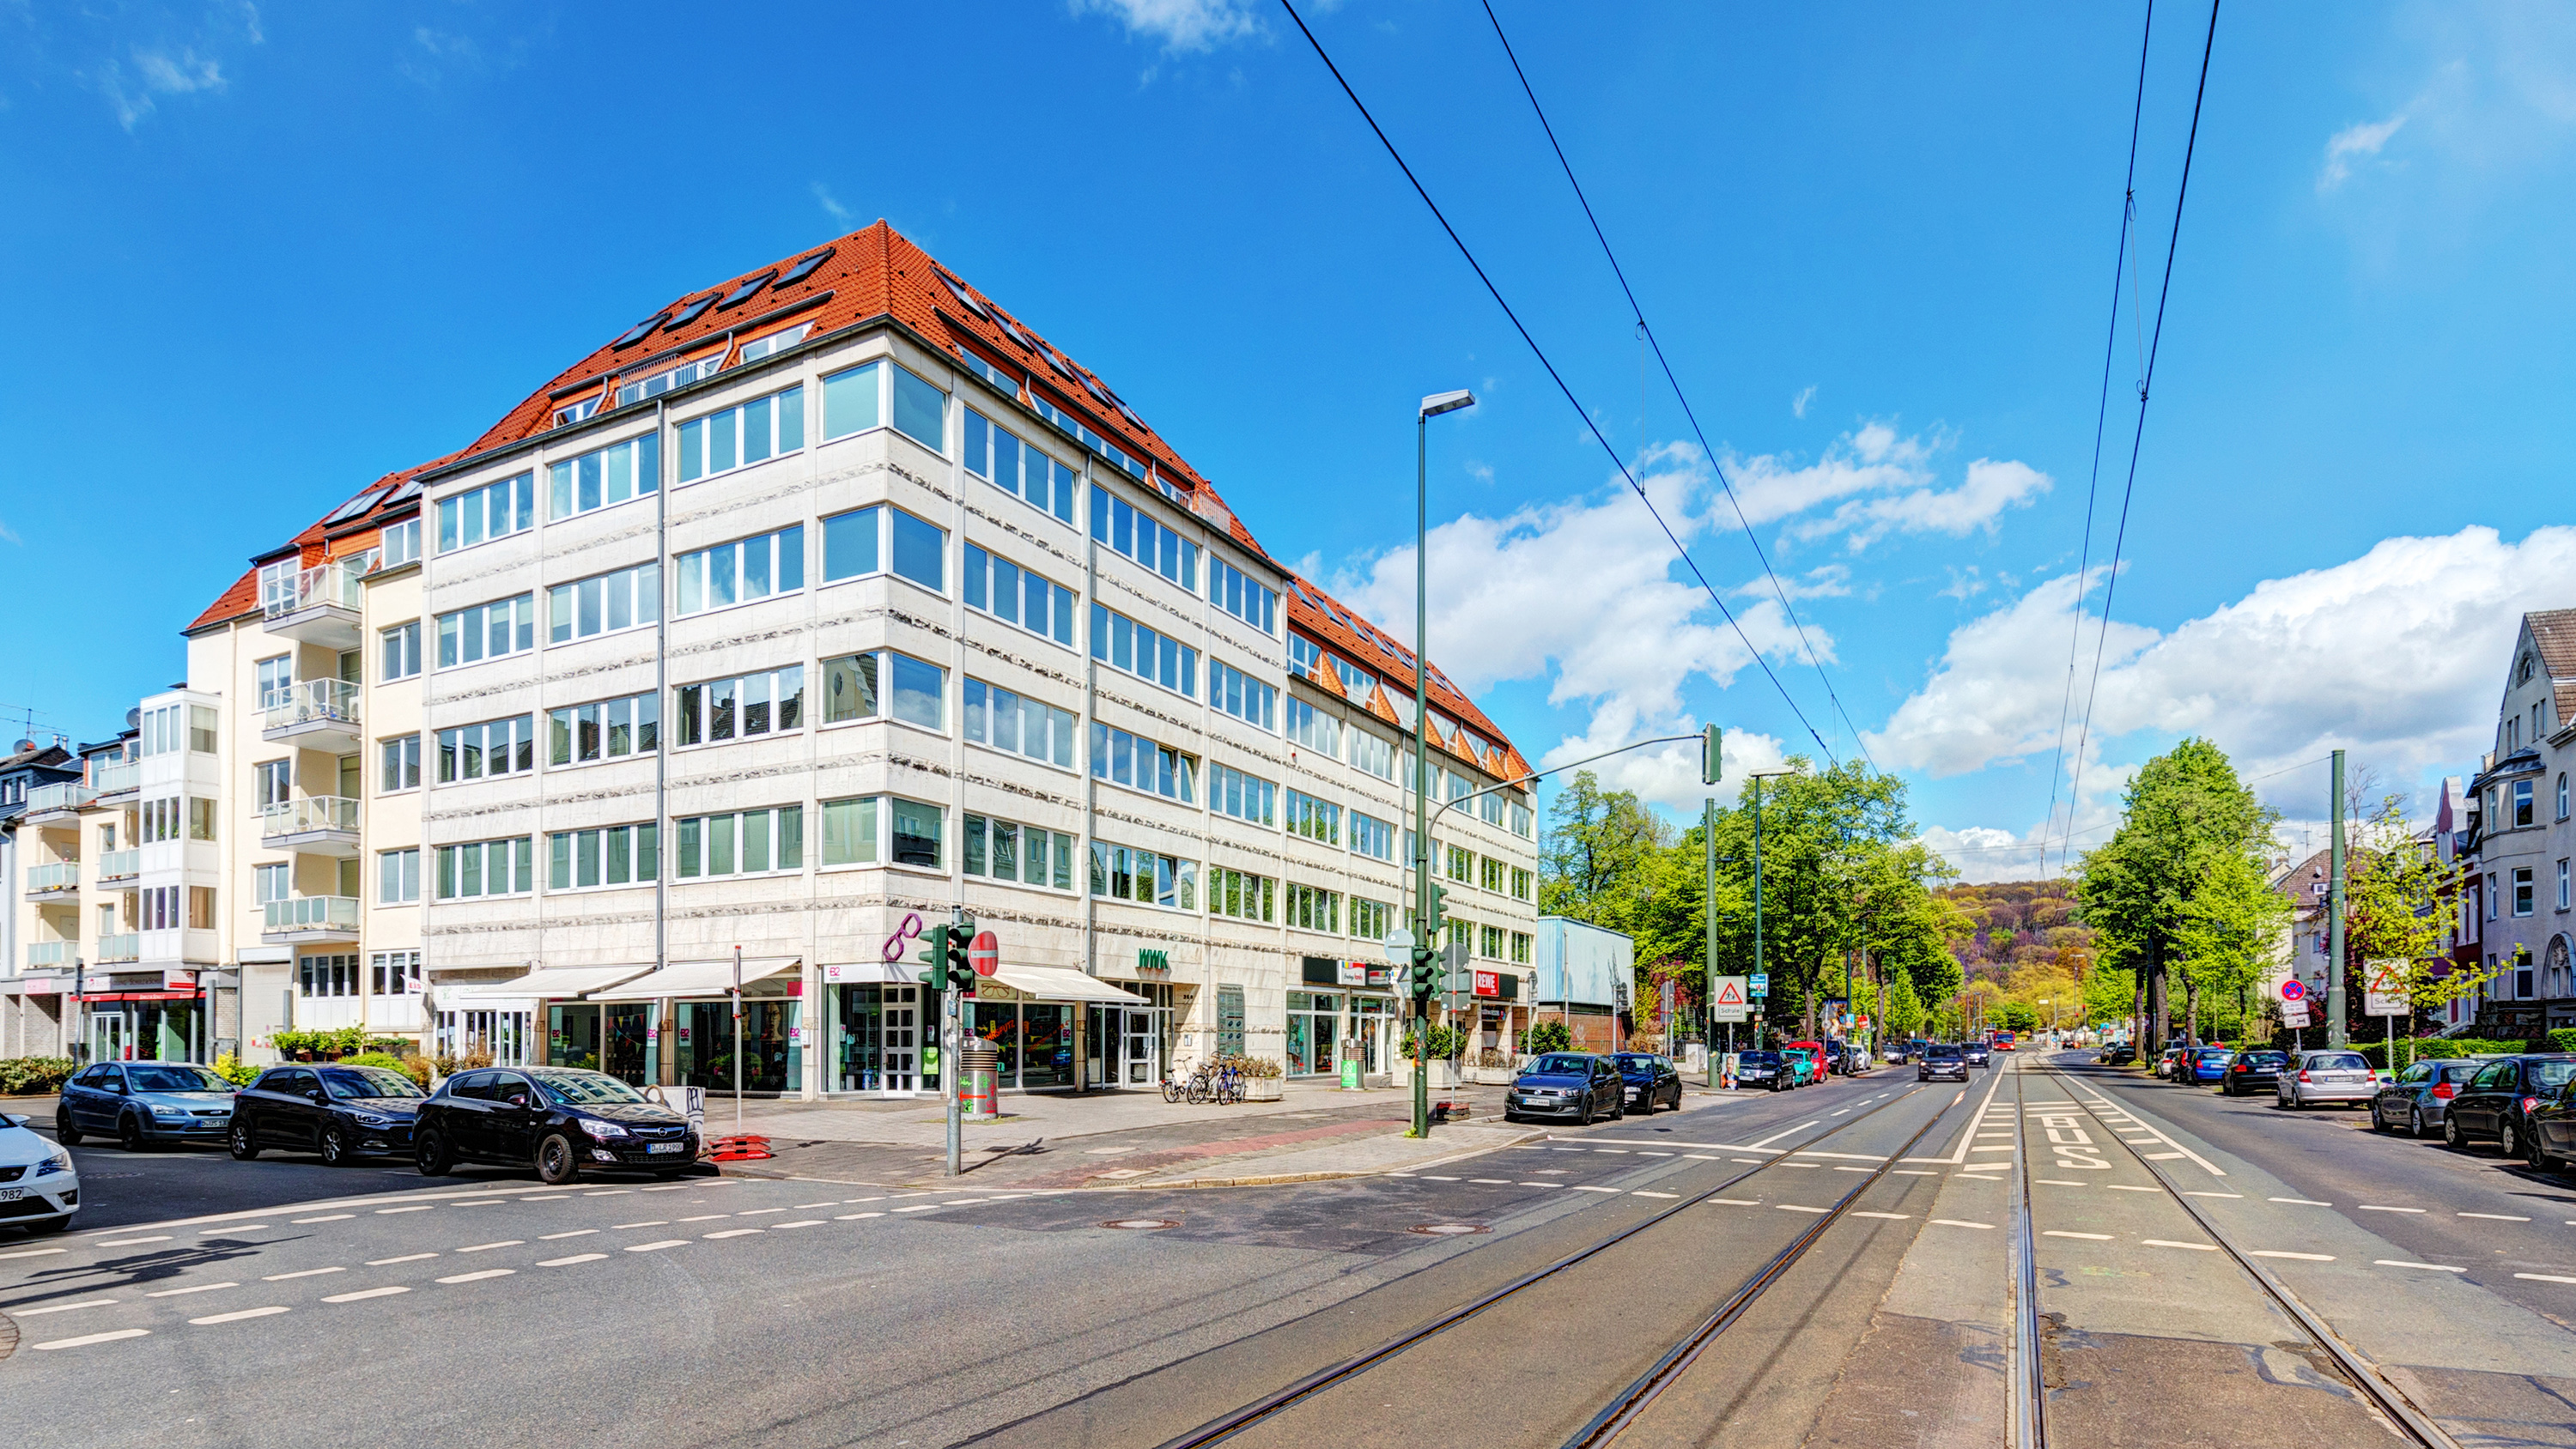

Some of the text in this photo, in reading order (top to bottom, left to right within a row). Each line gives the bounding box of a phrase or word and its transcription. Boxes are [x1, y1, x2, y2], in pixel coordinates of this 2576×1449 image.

[1139, 949, 1168, 969] WWK
[829, 967, 840, 976] B2
[1478, 973, 1495, 989] REWE
[552, 1029, 561, 1038] B2
[680, 1028, 690, 1037] B2
[790, 1028, 799, 1036] B2
[1062, 1029, 1071, 1038] B2
[2041, 1117, 2112, 1169] BUS
